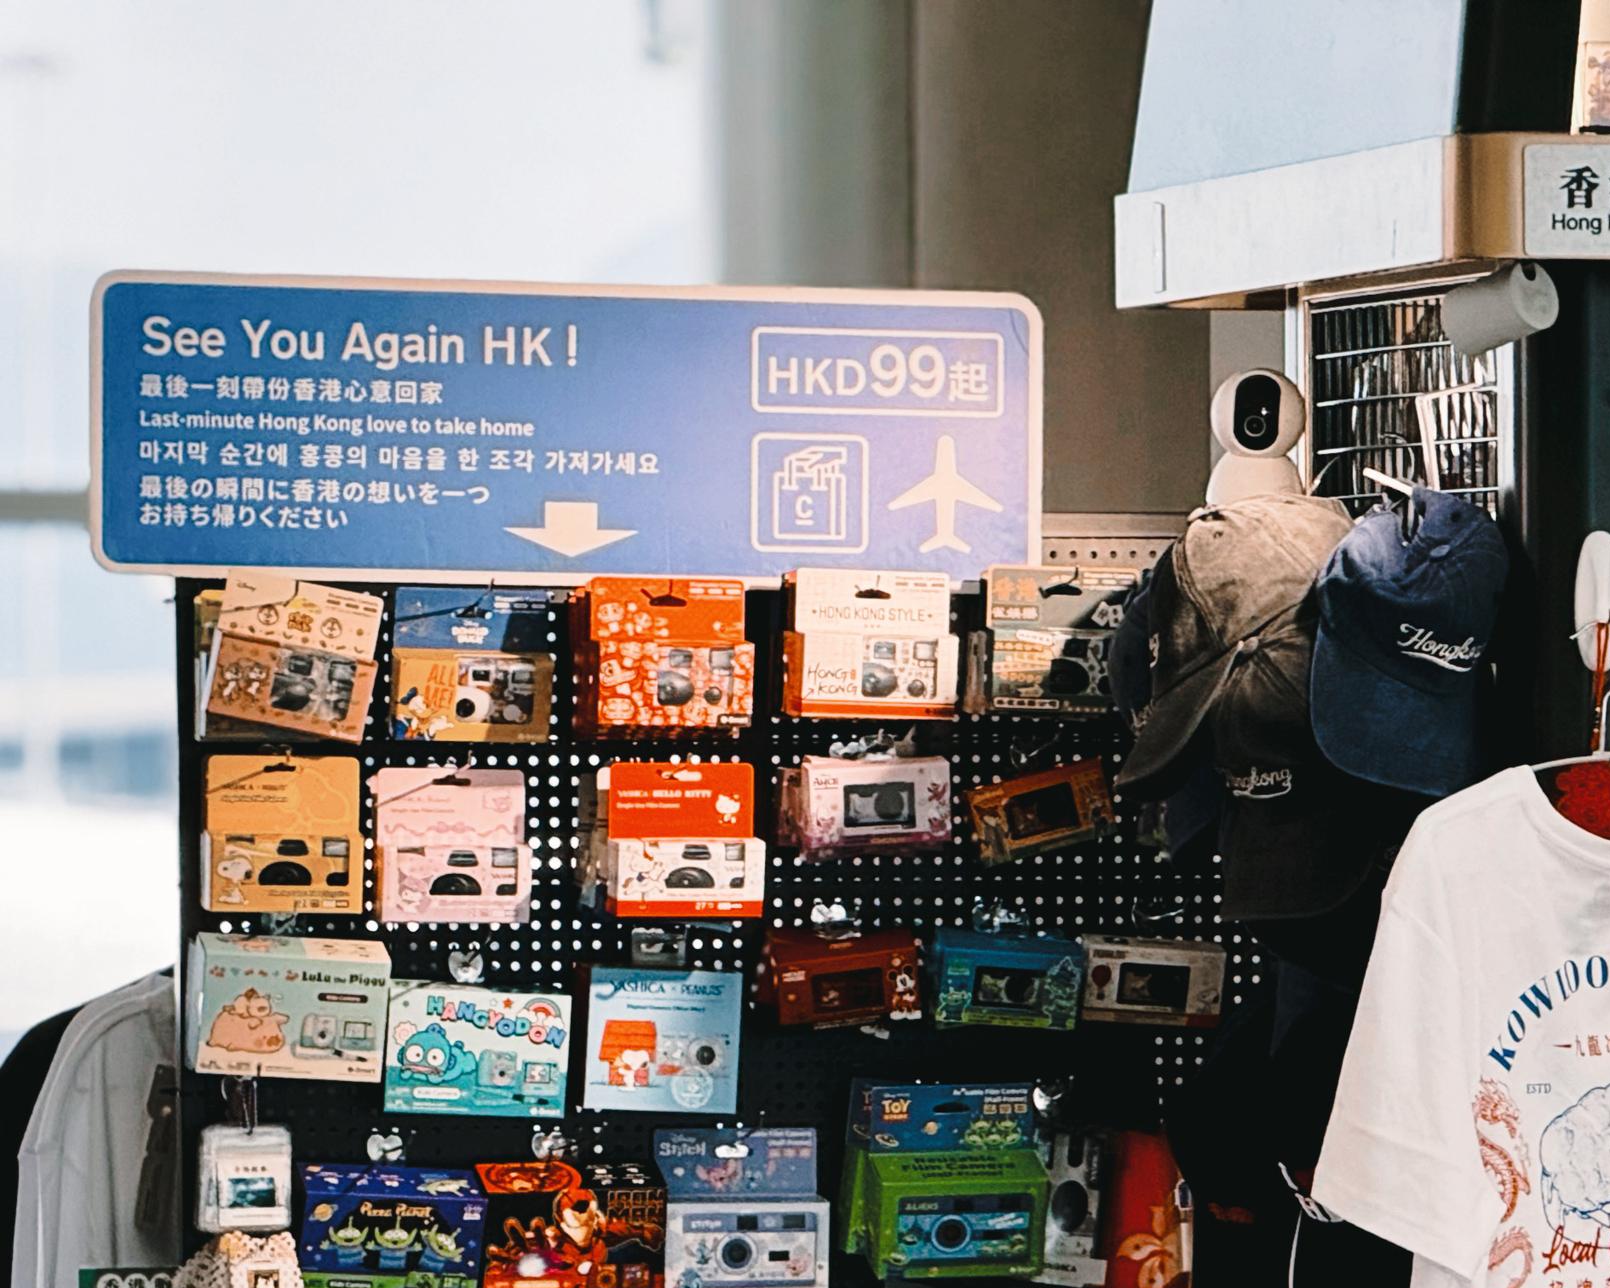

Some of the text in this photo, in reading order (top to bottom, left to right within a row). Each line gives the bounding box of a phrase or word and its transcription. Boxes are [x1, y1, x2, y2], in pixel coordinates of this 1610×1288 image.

[1551, 213, 1602, 235] Hong
[142, 315, 227, 358] See
[240, 318, 326, 361] You
[341, 321, 465, 371] Again
[483, 325, 553, 367] HK
[139, 373, 444, 405] 最後一刻帶份香港心意回家
[258, 412, 311, 434] Hong
[313, 413, 363, 437] Kong
[366, 414, 407, 433] love
[410, 417, 432, 434] to
[434, 415, 477, 435] take
[479, 416, 536, 437] home
[139, 439, 661, 476] 마지막 순간에 홍콩의 마음을 한 조각 가져가세요
[139, 474, 491, 506] 最後の瞬間に香港の想いを一つ
[139, 502, 350, 530] お持ち帰りください
[818, 606, 926, 623] HONG KONG STYLE
[1396, 623, 1482, 673] Hongk
[807, 664, 848, 686] HONG
[817, 682, 858, 695] KONG
[349, 973, 387, 988] Piggy
[426, 995, 567, 1050] HANGYODON
[1542, 1225, 1601, 1275] Local
